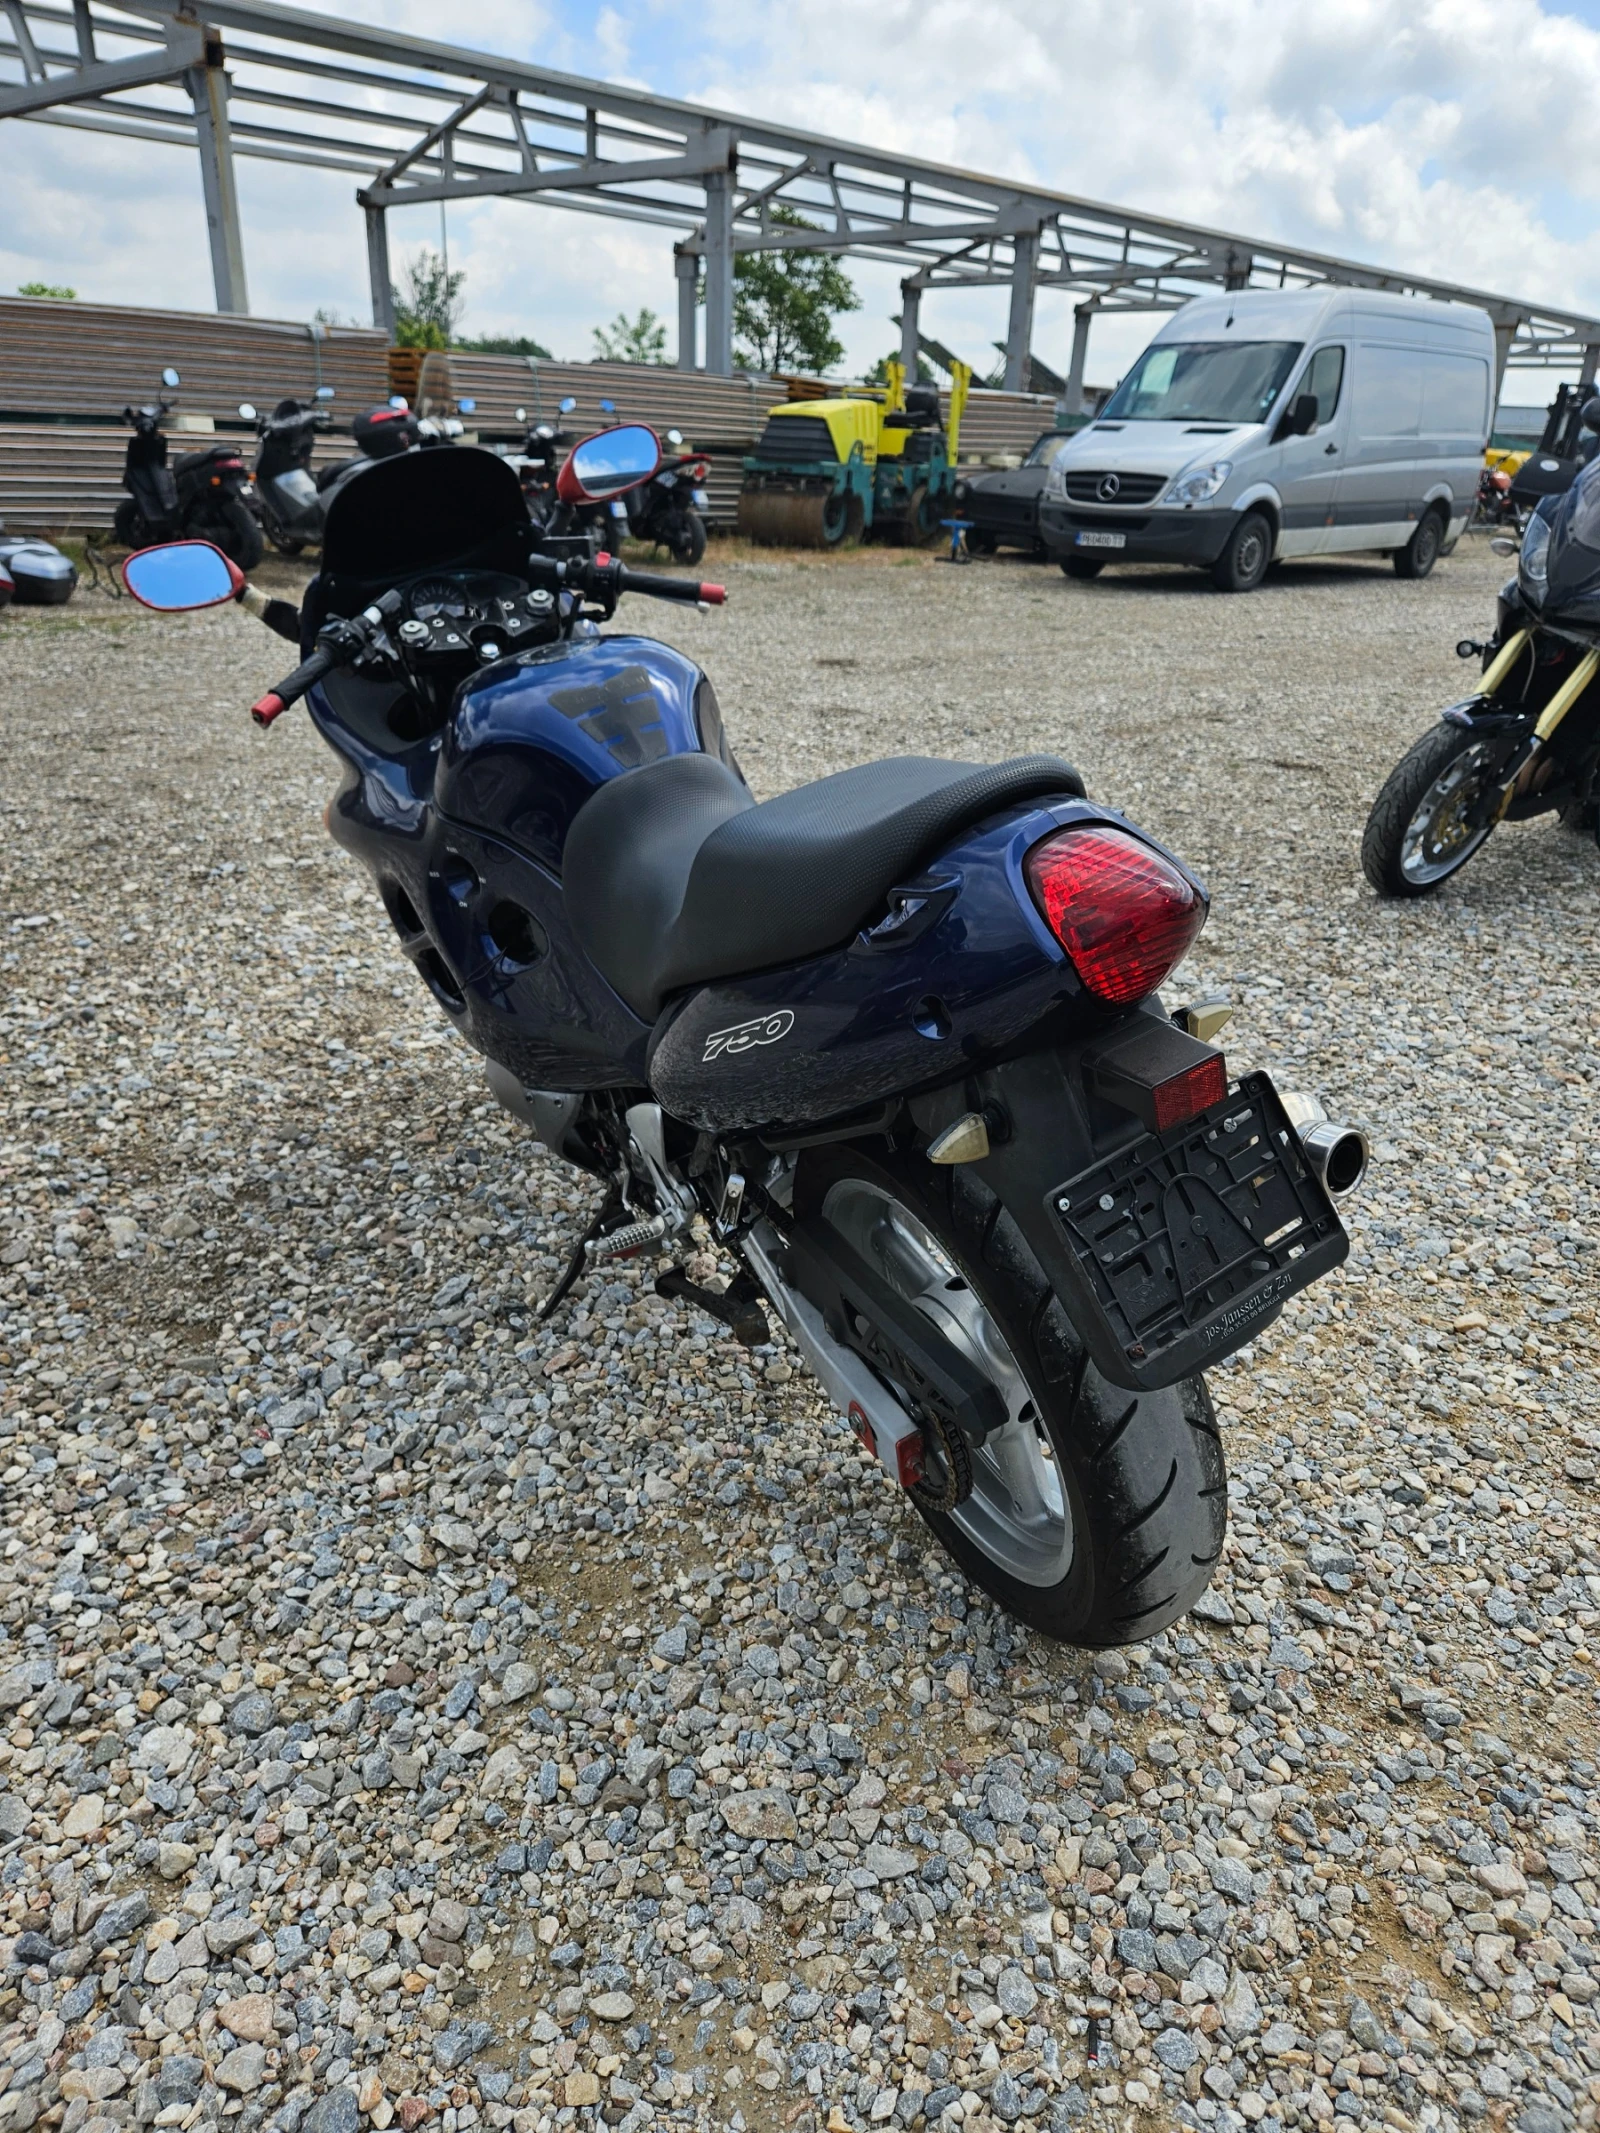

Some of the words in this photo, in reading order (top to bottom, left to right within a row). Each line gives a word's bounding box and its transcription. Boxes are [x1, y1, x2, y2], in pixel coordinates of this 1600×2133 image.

[702, 1009, 795, 1062] 750
[1263, 1284, 1274, 1299] &
[1258, 1294, 1281, 1313] BRUGGE
